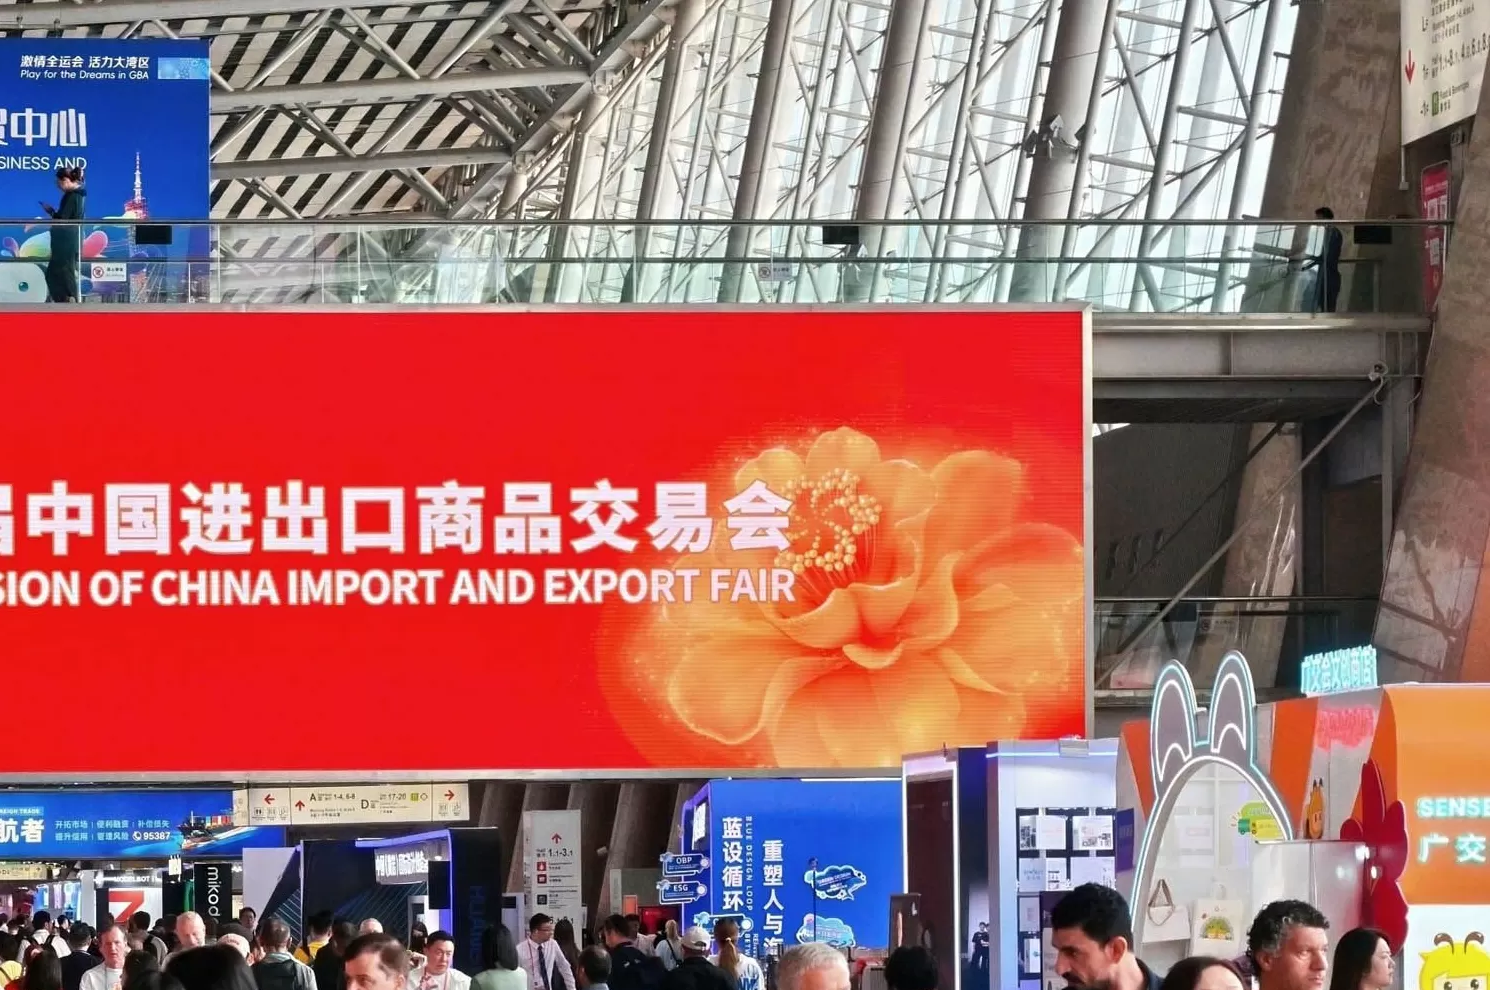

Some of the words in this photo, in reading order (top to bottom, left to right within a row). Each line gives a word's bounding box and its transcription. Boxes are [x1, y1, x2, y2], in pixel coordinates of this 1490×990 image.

[20, 55, 84, 68] 激情全运会
[89, 56, 150, 69] 活力大湾区
[20, 70, 40, 80] Play
[44, 70, 58, 79] for
[60, 70, 77, 79] the
[79, 70, 115, 79] Dreams
[118, 70, 126, 79] in
[129, 71, 149, 79] GBA
[54, 156, 87, 170] AND
[90, 571, 143, 606] OF
[151, 570, 277, 606] CHINA
[287, 569, 443, 605] IMPORT
[450, 569, 534, 605] AND
[545, 569, 700, 604] EXPORT
[711, 568, 796, 603] FAIR
[360, 798, 370, 810] D
[143, 831, 171, 841] 95387
[722, 817, 744, 912] 蓝设循环
[673, 884, 688, 892] ESG
[207, 866, 221, 925] mikod
